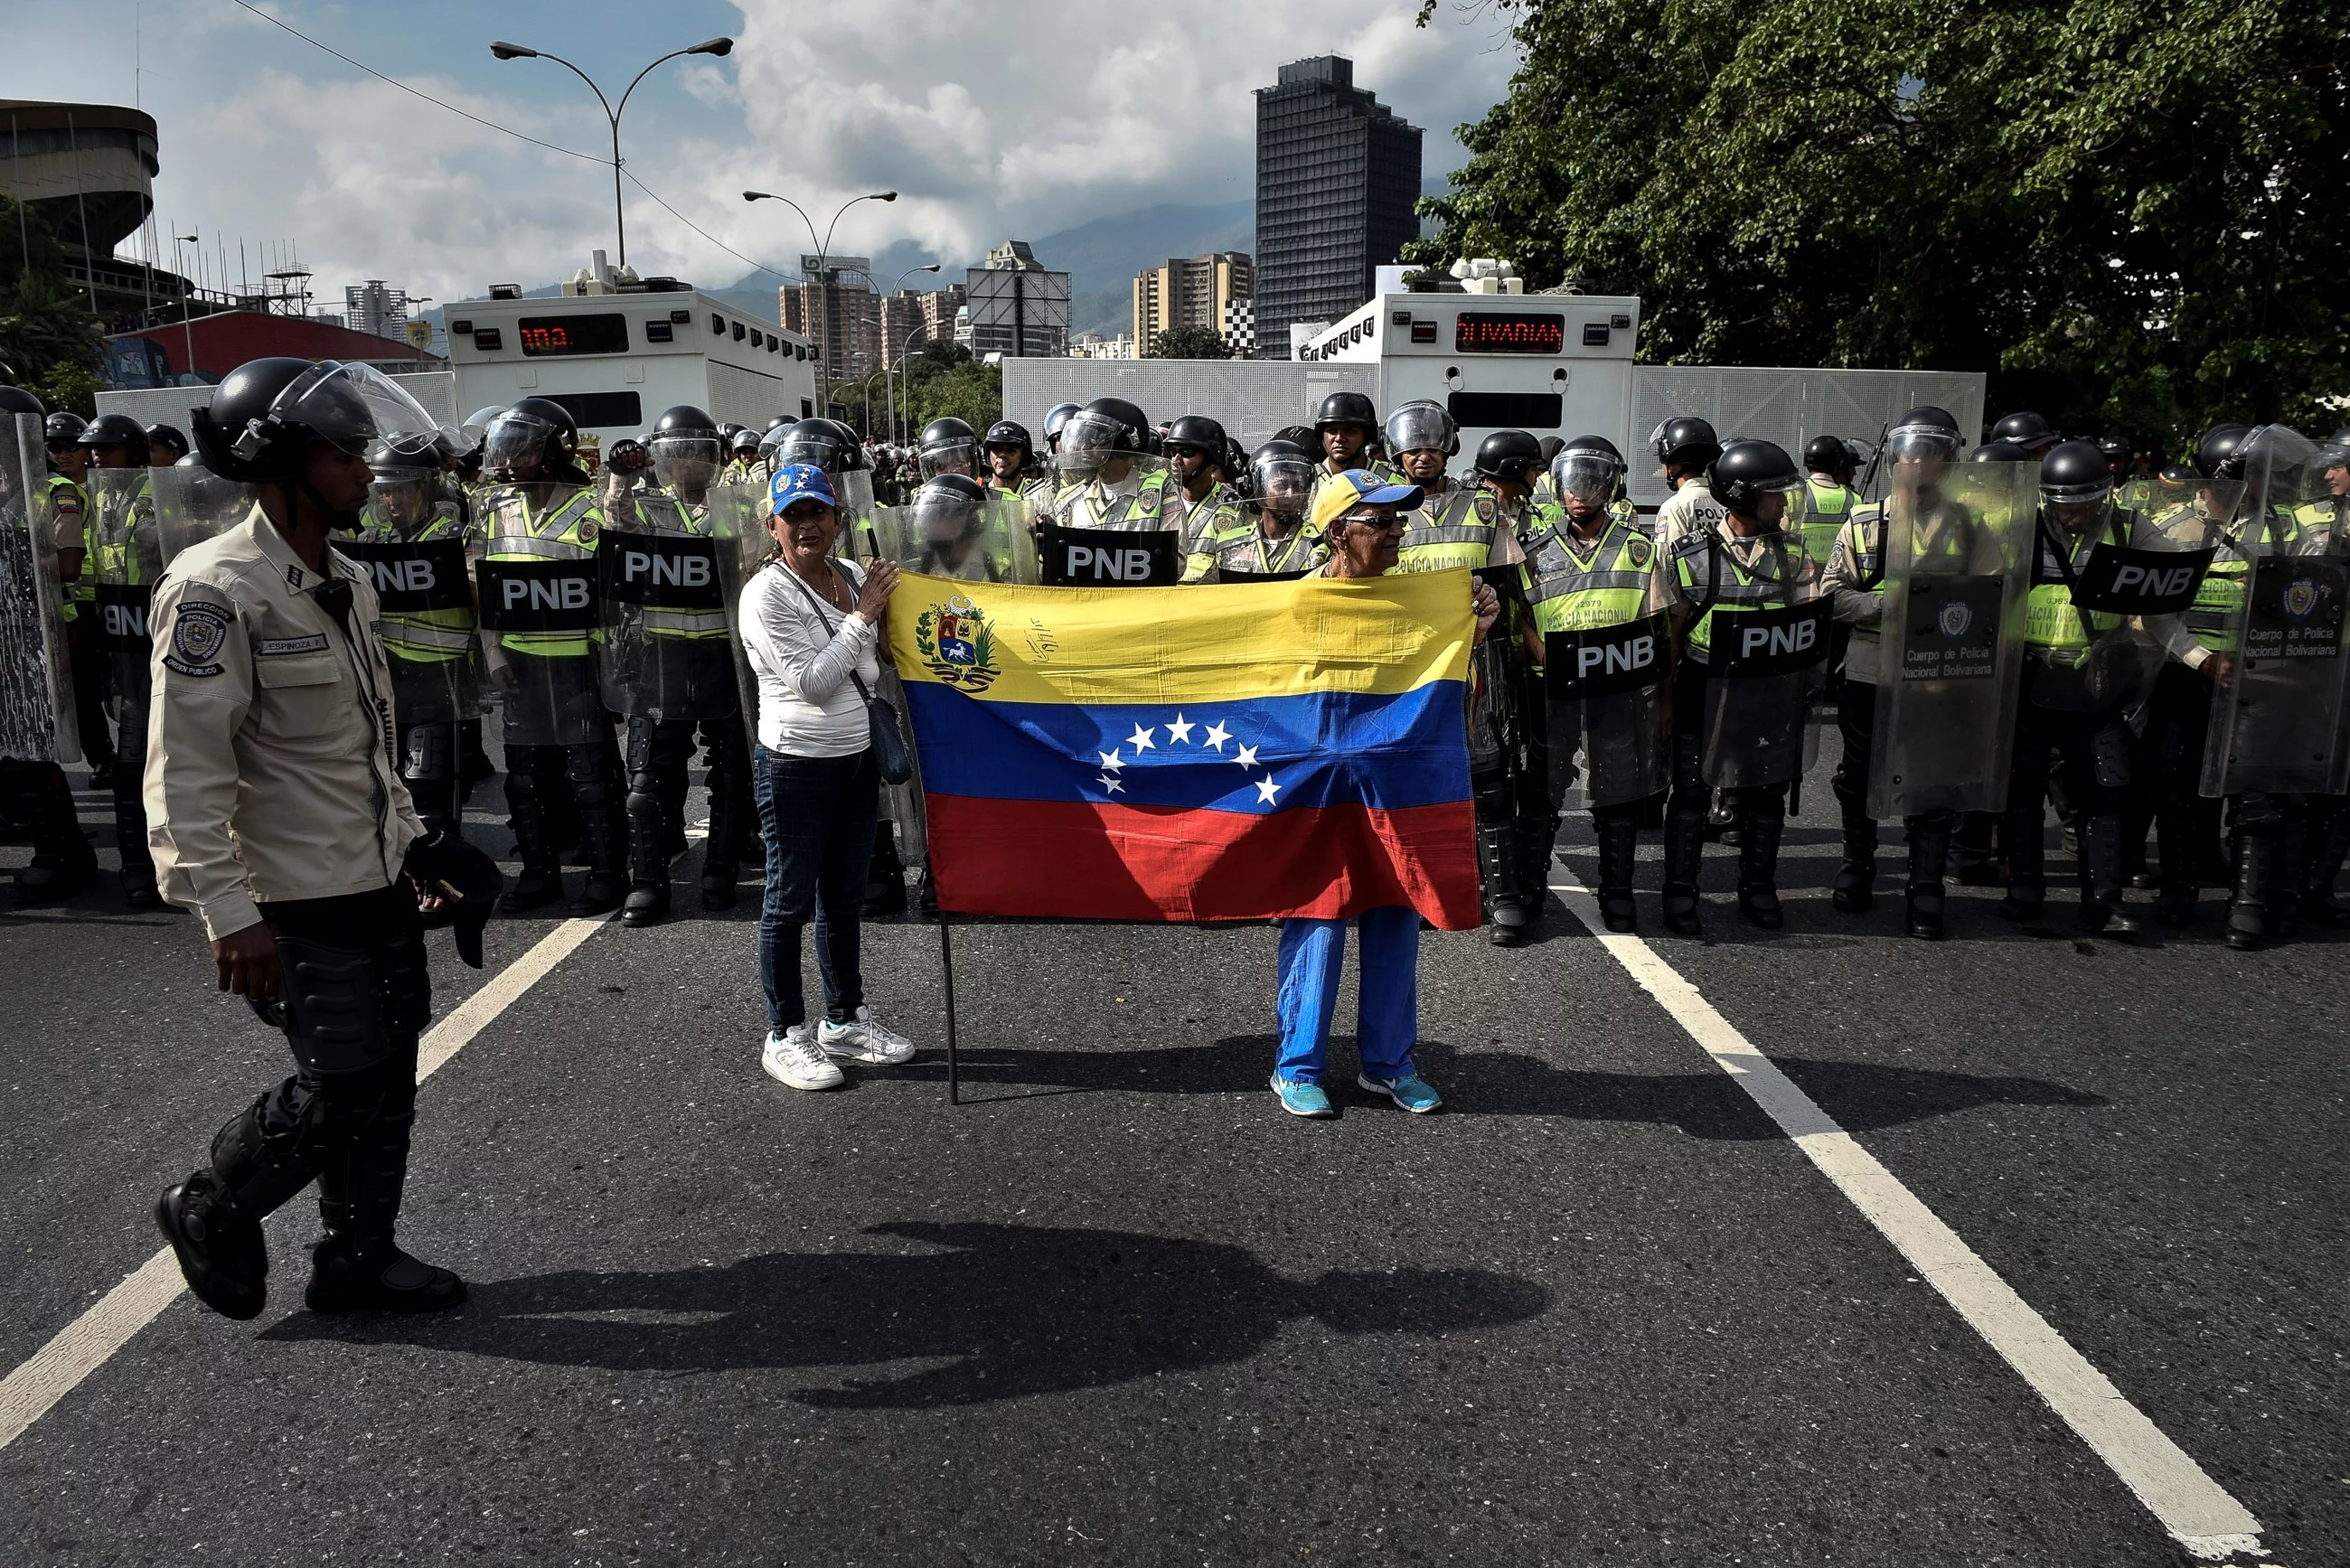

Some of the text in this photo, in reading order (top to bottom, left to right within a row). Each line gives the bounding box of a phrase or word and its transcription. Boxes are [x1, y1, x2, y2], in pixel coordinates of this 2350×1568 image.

[625, 550, 711, 587] PNB
[1067, 545, 1152, 580] PNB
[2110, 565, 2195, 596] PNB
[503, 577, 590, 610] PNB
[181, 603, 230, 619] DIRECCION
[1584, 608, 1628, 624] NACIONAL
[186, 615, 218, 625] POLICIA
[176, 622, 187, 653] NACIONAL
[1742, 618, 1817, 658] PNB
[2249, 628, 2283, 643] Cuerpo
[2288, 627, 2299, 639] de
[268, 641, 312, 650] ESPINOZA
[2285, 643, 2336, 656] Bolivariana
[1577, 634, 1655, 679] PNB
[1907, 649, 1940, 663] Cuerpo
[1944, 647, 1956, 660] de
[166, 659, 187, 673] ORDEN
[1902, 662, 1992, 679] Nacional Bolivariana
